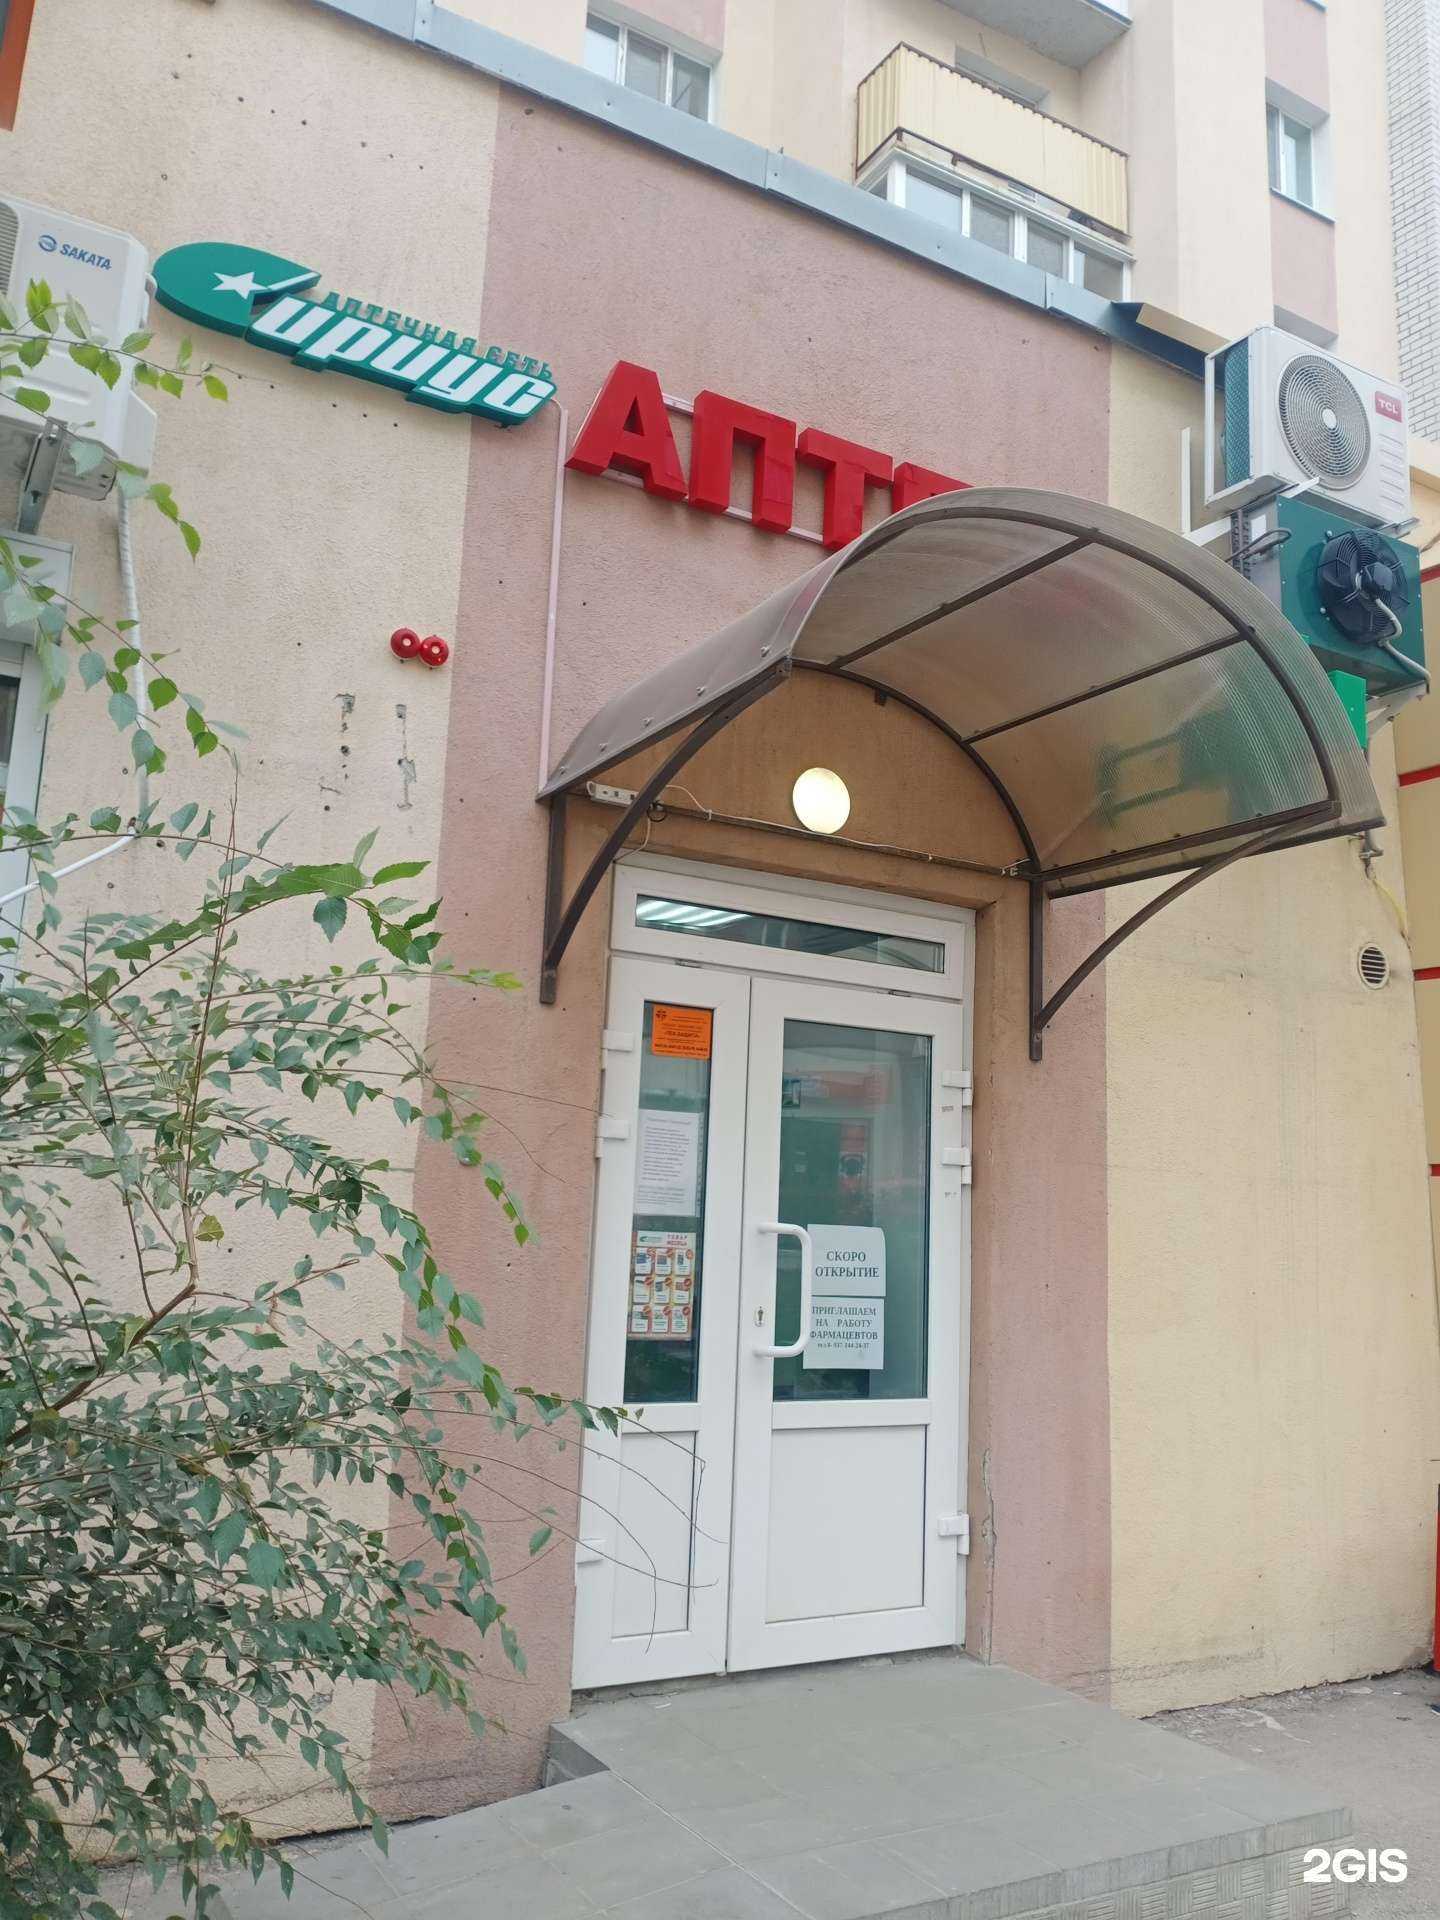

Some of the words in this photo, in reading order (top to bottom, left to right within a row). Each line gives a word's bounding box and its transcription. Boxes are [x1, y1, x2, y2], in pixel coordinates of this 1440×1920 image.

[60, 243, 112, 270] SAKATA
[320, 291, 477, 351] АПТЕЧНАЯ
[487, 346, 553, 379] СЕТЬ
[1378, 398, 1398, 414] TCL
[826, 1251, 866, 1261] СКОРО
[815, 1266, 880, 1277] ОТКРЫТИЕ
[812, 1306, 876, 1315] ПРИГЛАШАЕМ
[816, 1319, 828, 1327] НА
[837, 1319, 872, 1327] РАБОТУ
[810, 1331, 878, 1341] ФАРМАЦЕВТОВ
